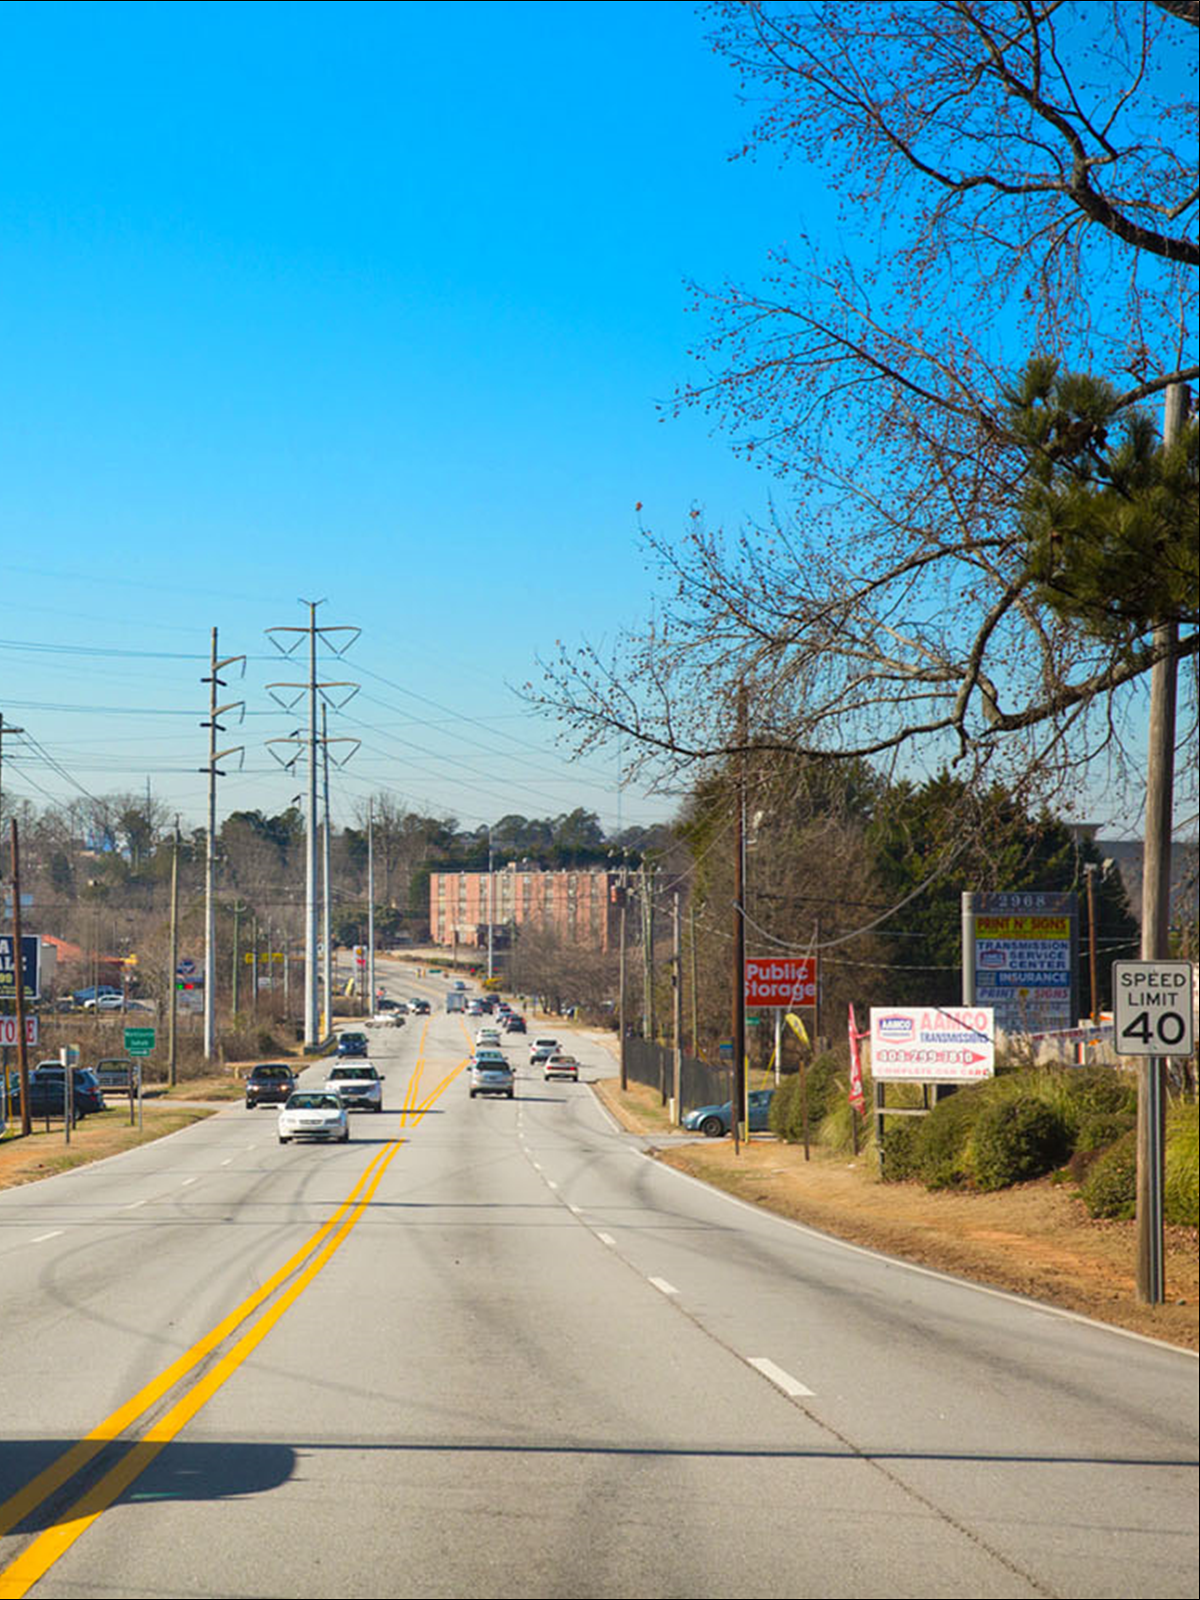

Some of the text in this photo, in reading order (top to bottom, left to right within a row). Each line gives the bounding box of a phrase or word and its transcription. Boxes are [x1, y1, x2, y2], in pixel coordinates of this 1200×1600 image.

[999, 895, 1046, 907] 2968
[977, 917, 1009, 930] PRINT
[1031, 917, 1067, 930] SIGNS
[977, 942, 1068, 950] TRANSMISSION
[1010, 952, 1065, 960] SERVICE
[1009, 961, 1066, 969] CENTER
[746, 963, 809, 980] Public
[999, 971, 1068, 983] INSURANCE
[1121, 972, 1187, 988] SPEED
[979, 988, 1068, 998] PRINT SIGNS
[1128, 992, 1179, 1007] LIMIT
[921, 1011, 988, 1030] AAMCO
[1121, 1011, 1186, 1045] 40
